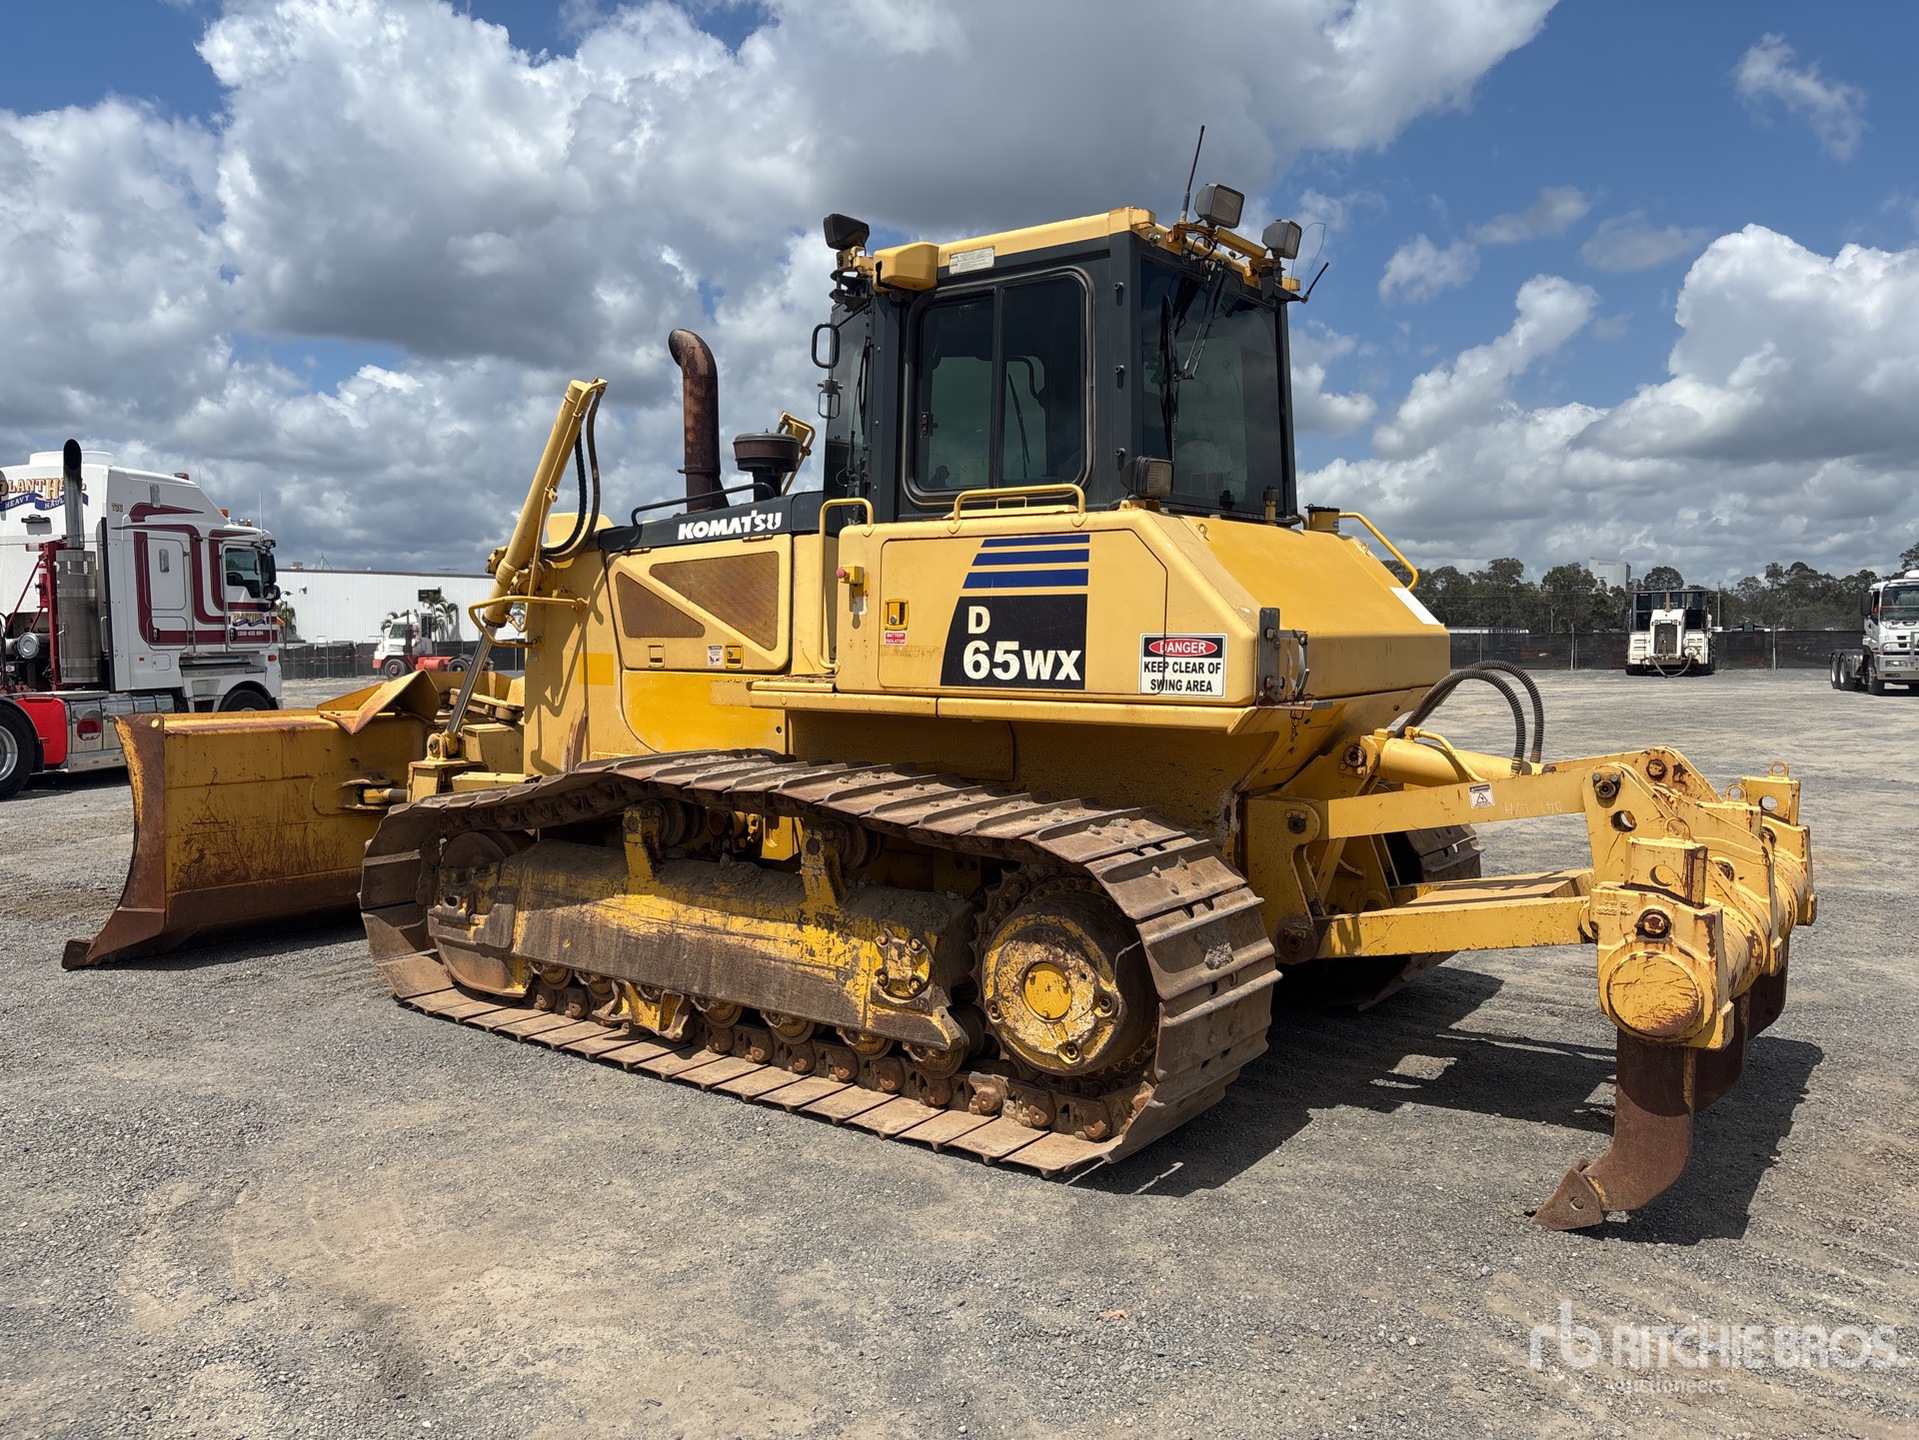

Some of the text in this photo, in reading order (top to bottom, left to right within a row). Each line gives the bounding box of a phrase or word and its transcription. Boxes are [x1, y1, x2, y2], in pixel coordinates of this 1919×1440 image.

[0, 477, 87, 501] PLANTH
[5, 495, 30, 509] HEAVY
[677, 510, 782, 540] KOMATSU
[967, 605, 991, 634] D
[1160, 641, 1206, 654] DANGER
[963, 640, 1081, 681] 65WX
[1143, 661, 1221, 674] KEEP CLEAR OF
[1150, 678, 1213, 692] SWING AREA
